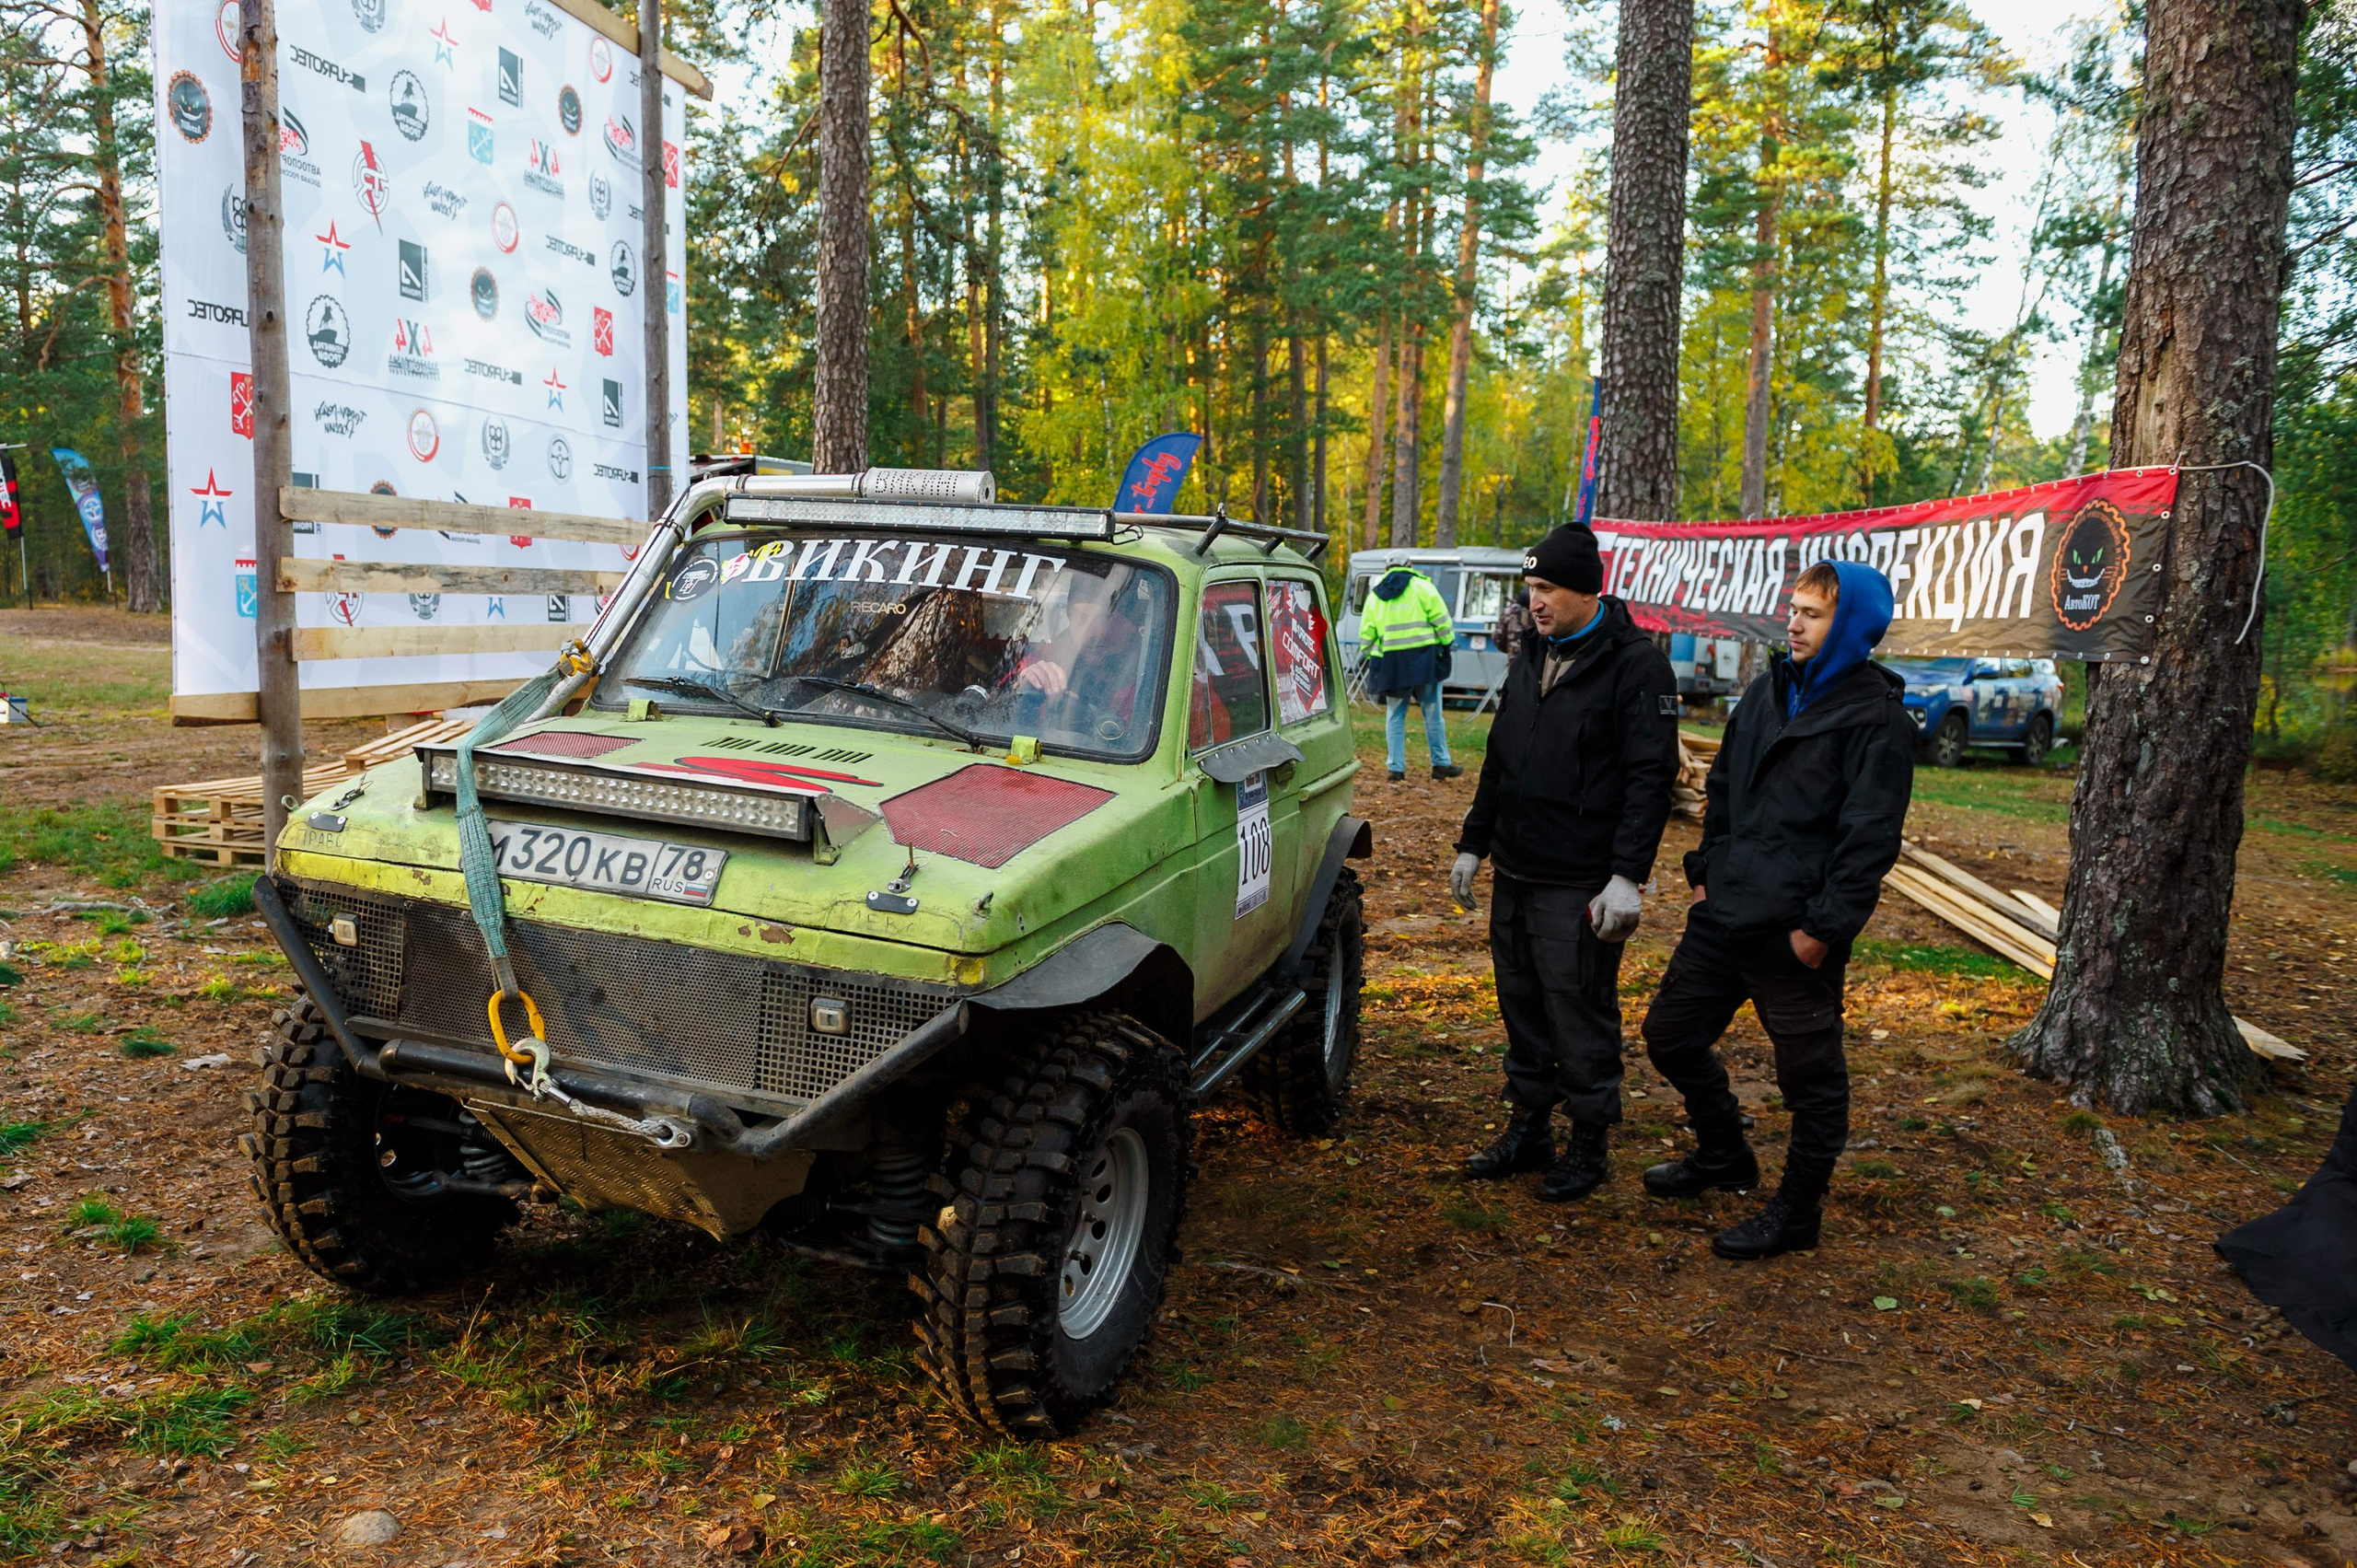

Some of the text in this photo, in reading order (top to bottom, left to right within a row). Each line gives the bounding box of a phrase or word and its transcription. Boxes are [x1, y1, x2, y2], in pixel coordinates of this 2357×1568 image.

[875, 470, 969, 497] ВИКИНГ
[741, 540, 1066, 599] ВИКИНГ
[1608, 536, 1789, 615] ТЕХНИЧЕСКАЯ
[851, 601, 907, 615] RECARO
[2064, 594, 2101, 610] АвтоКОТ
[1282, 631, 1319, 679] COMFORT
[662, 846, 707, 881] 78
[1240, 816, 1271, 886] 108
[652, 877, 684, 894] RUS
